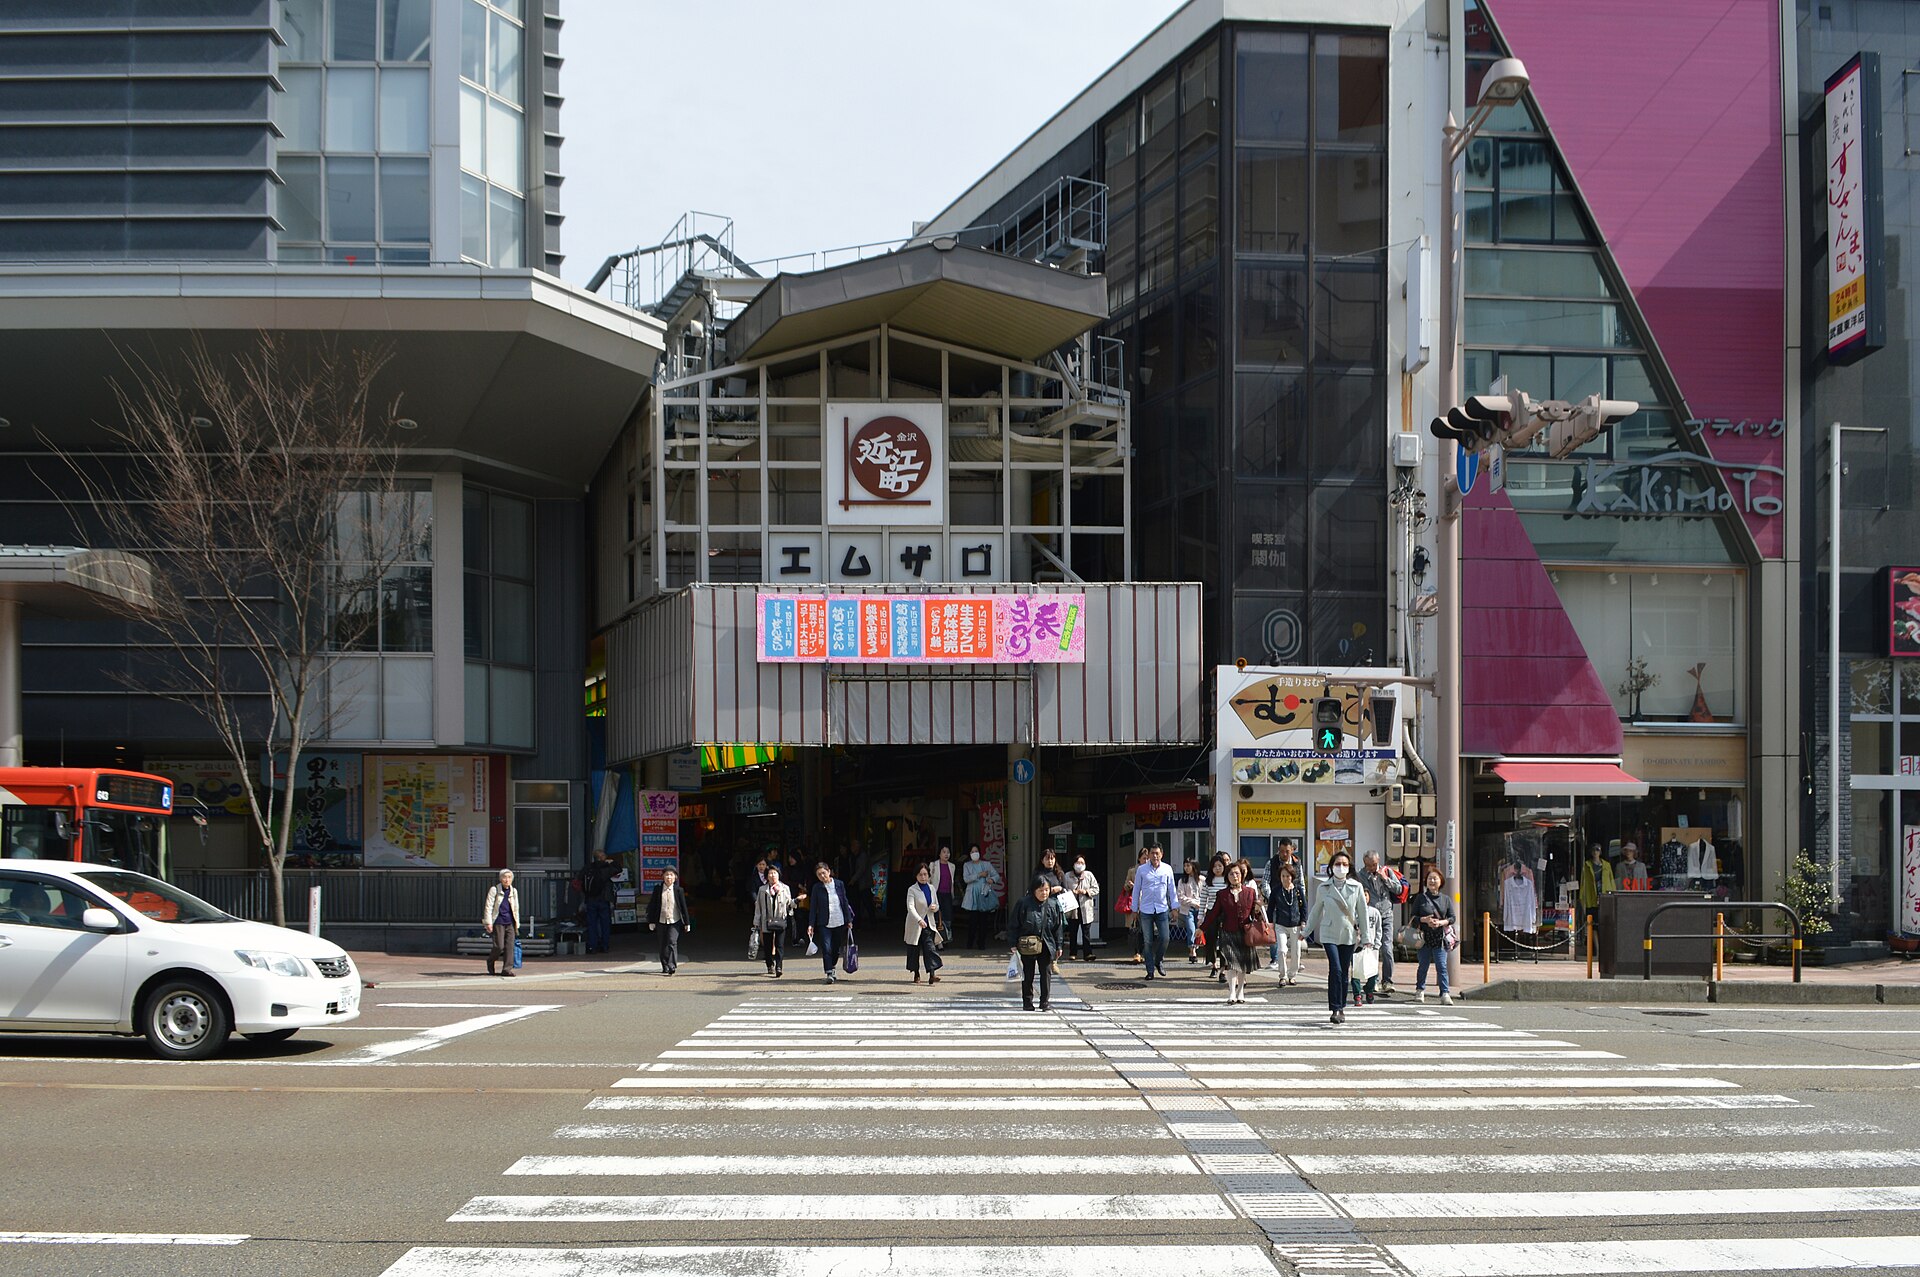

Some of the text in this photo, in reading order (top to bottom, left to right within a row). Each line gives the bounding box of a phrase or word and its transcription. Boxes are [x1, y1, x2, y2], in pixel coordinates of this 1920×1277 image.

[896, 432, 917, 442] 金沢
[1684, 416, 1784, 438] ブティック
[856, 432, 924, 493] 近江町
[943, 603, 957, 653] 解体特売
[960, 604, 974, 653] 生本マグロ
